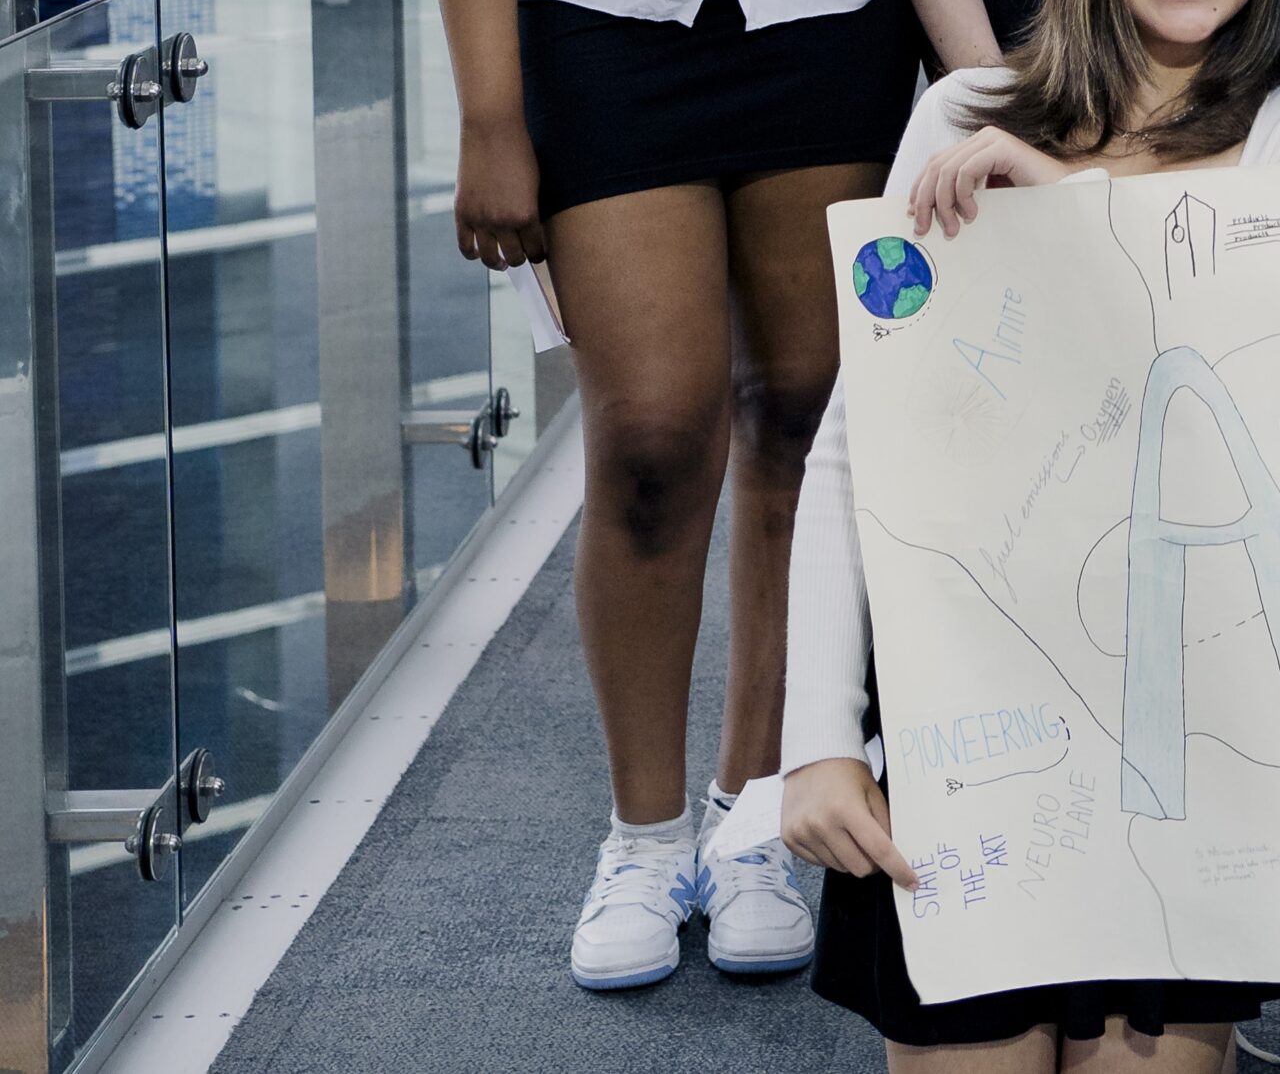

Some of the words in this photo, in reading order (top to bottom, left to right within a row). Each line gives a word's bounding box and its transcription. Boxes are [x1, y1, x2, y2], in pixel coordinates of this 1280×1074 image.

[1081, 376, 1124, 443] Oxygen
[979, 513, 1021, 605] fuel
[1020, 430, 1070, 519] emissions
[899, 703, 1061, 785] PIONEERING
[1017, 793, 1061, 901] NEURO
[1060, 769, 1097, 855] PLANE
[937, 842, 961, 870] OF
[960, 864, 986, 910] THE
[979, 834, 1009, 866] ART
